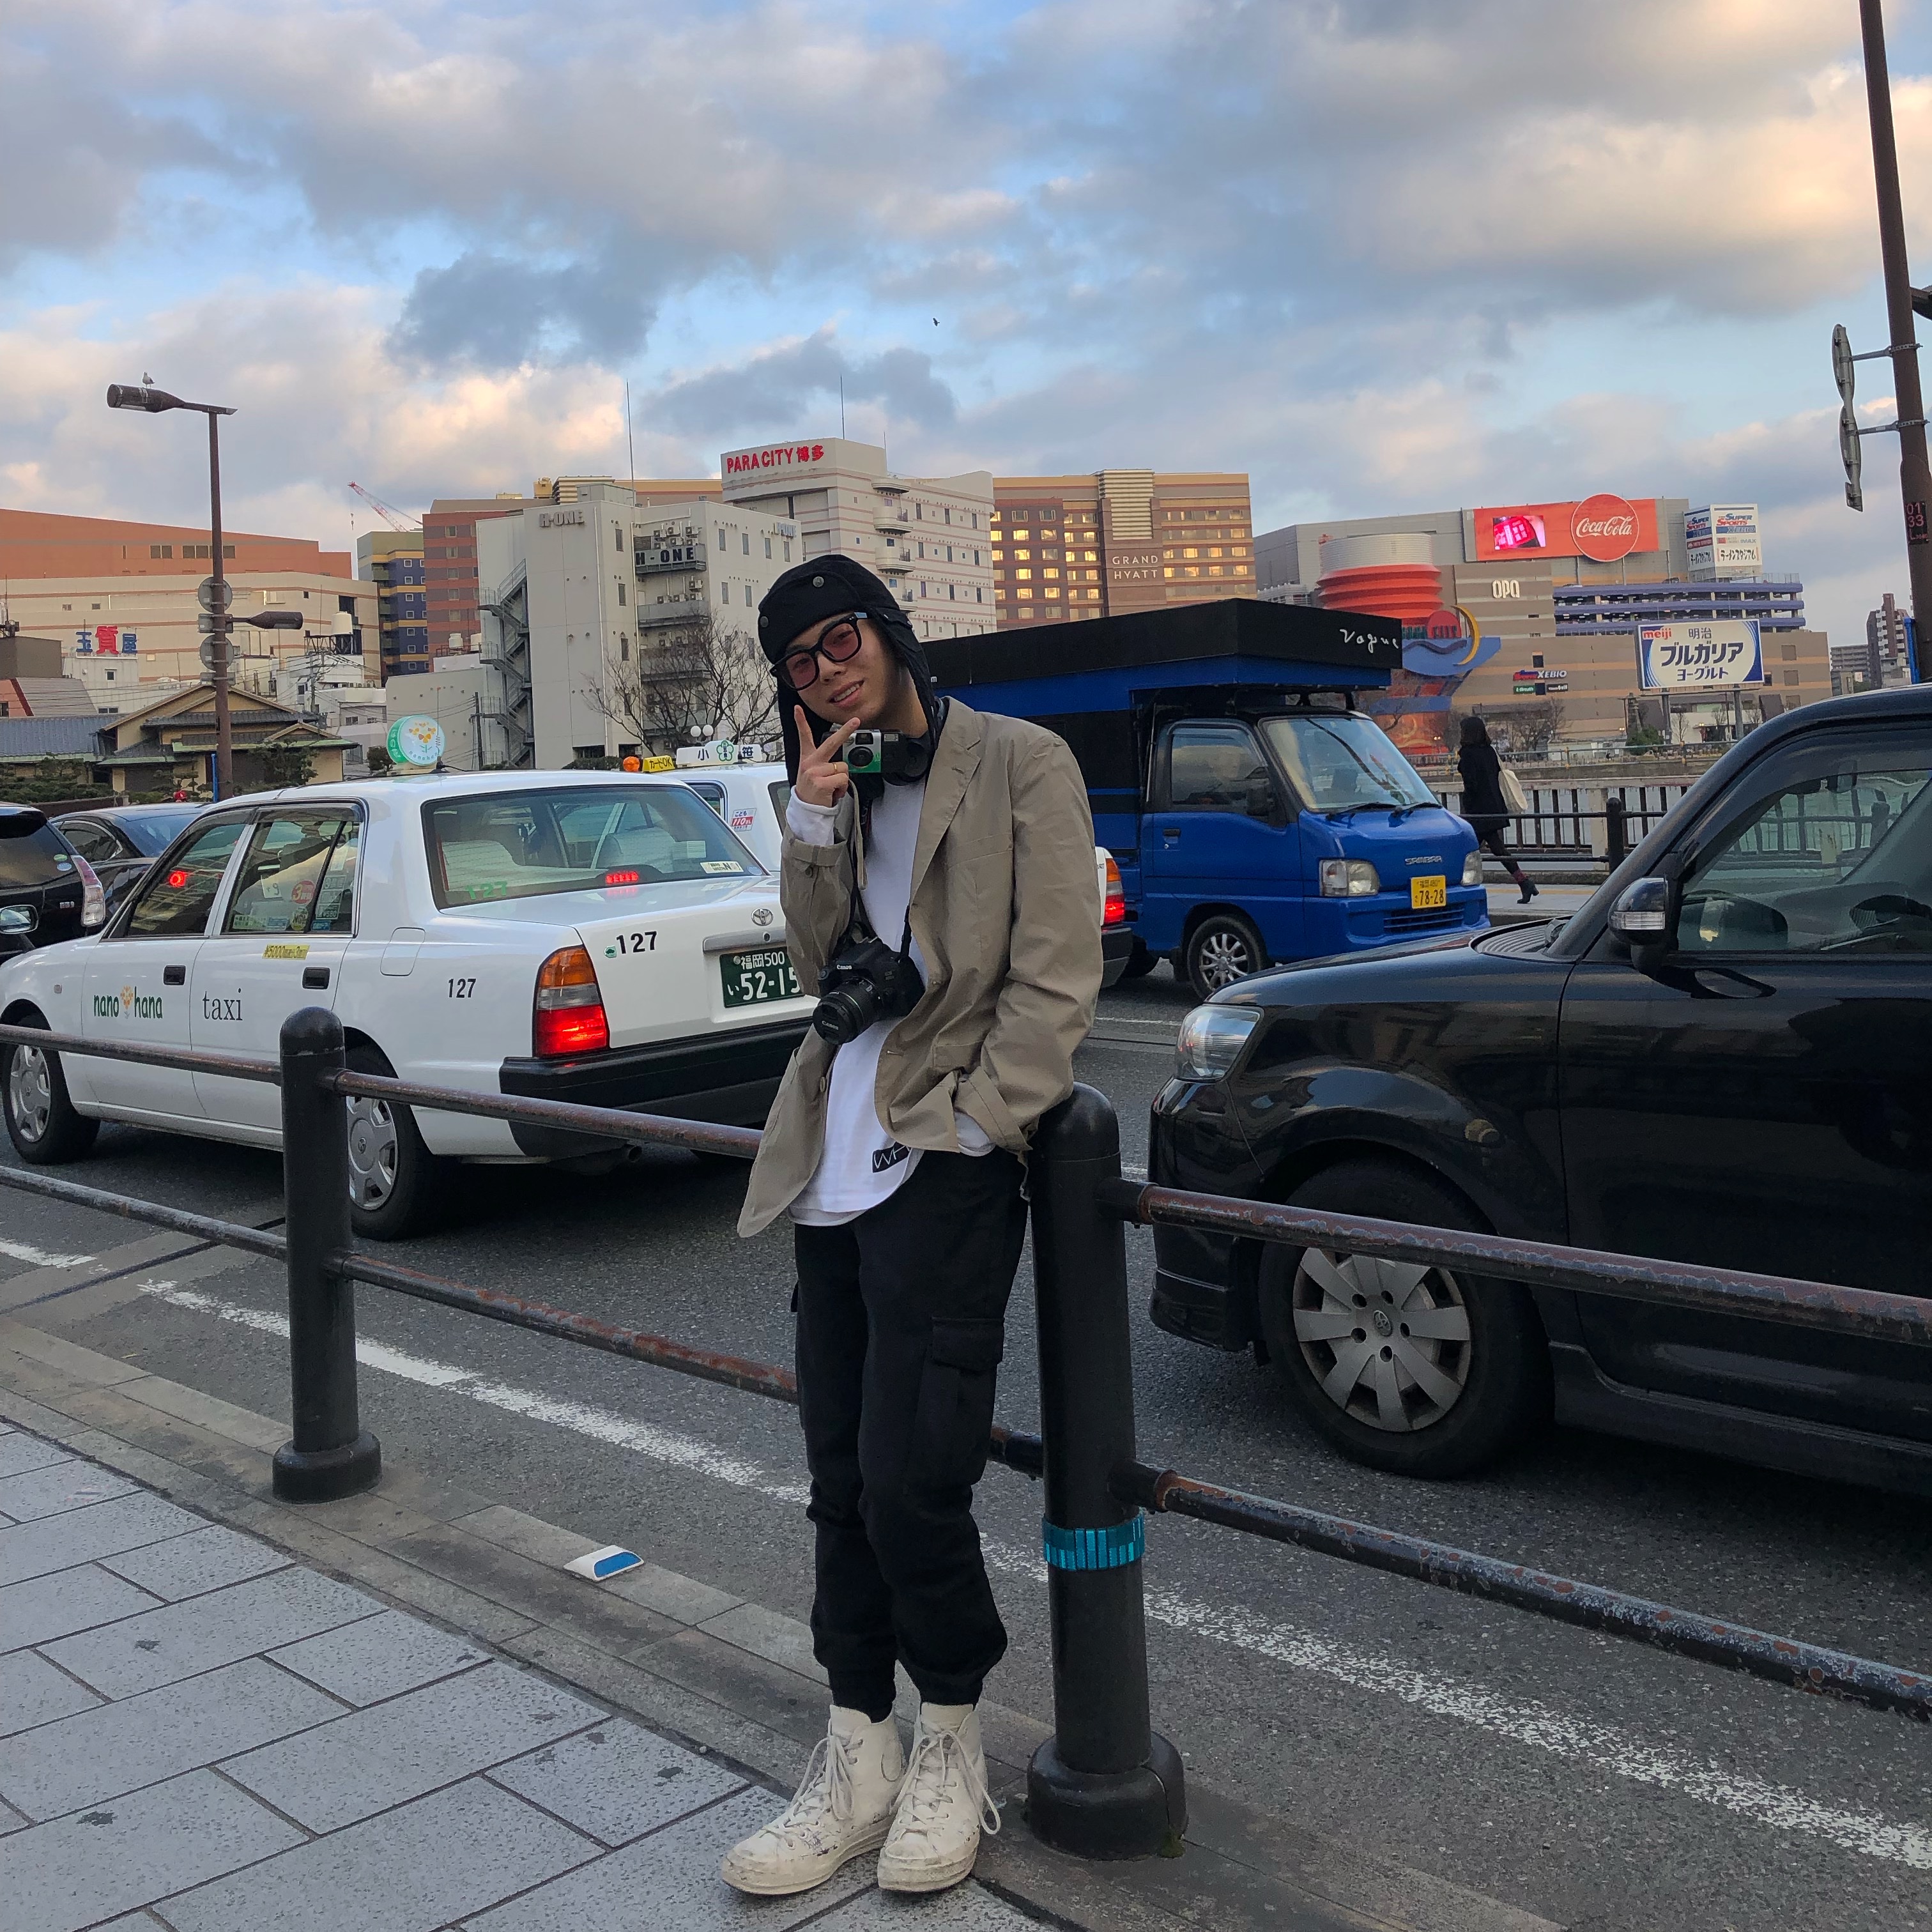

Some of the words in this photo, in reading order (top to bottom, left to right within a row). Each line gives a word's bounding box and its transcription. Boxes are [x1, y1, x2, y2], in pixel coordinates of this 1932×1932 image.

[796, 445, 824, 463] 博多
[1575, 516, 1634, 538] Coca-Cola
[1112, 555, 1158, 565] GRAND
[1114, 570, 1158, 579] HYATT
[1340, 629, 1399, 653] Vogue
[1643, 627, 1672, 640] meiji
[1688, 627, 1712, 640] 明治
[1660, 640, 1744, 666] ブルガリア
[1537, 670, 1567, 678] XEBIO
[1677, 666, 1729, 681] ヨーグルト
[697, 748, 710, 761] 小
[1419, 889, 1444, 906] 78-28
[616, 931, 657, 954] 127
[448, 978, 477, 998] 127
[93, 995, 119, 1017] nano
[134, 986, 163, 1018] hana
[203, 988, 243, 1020] taxi
